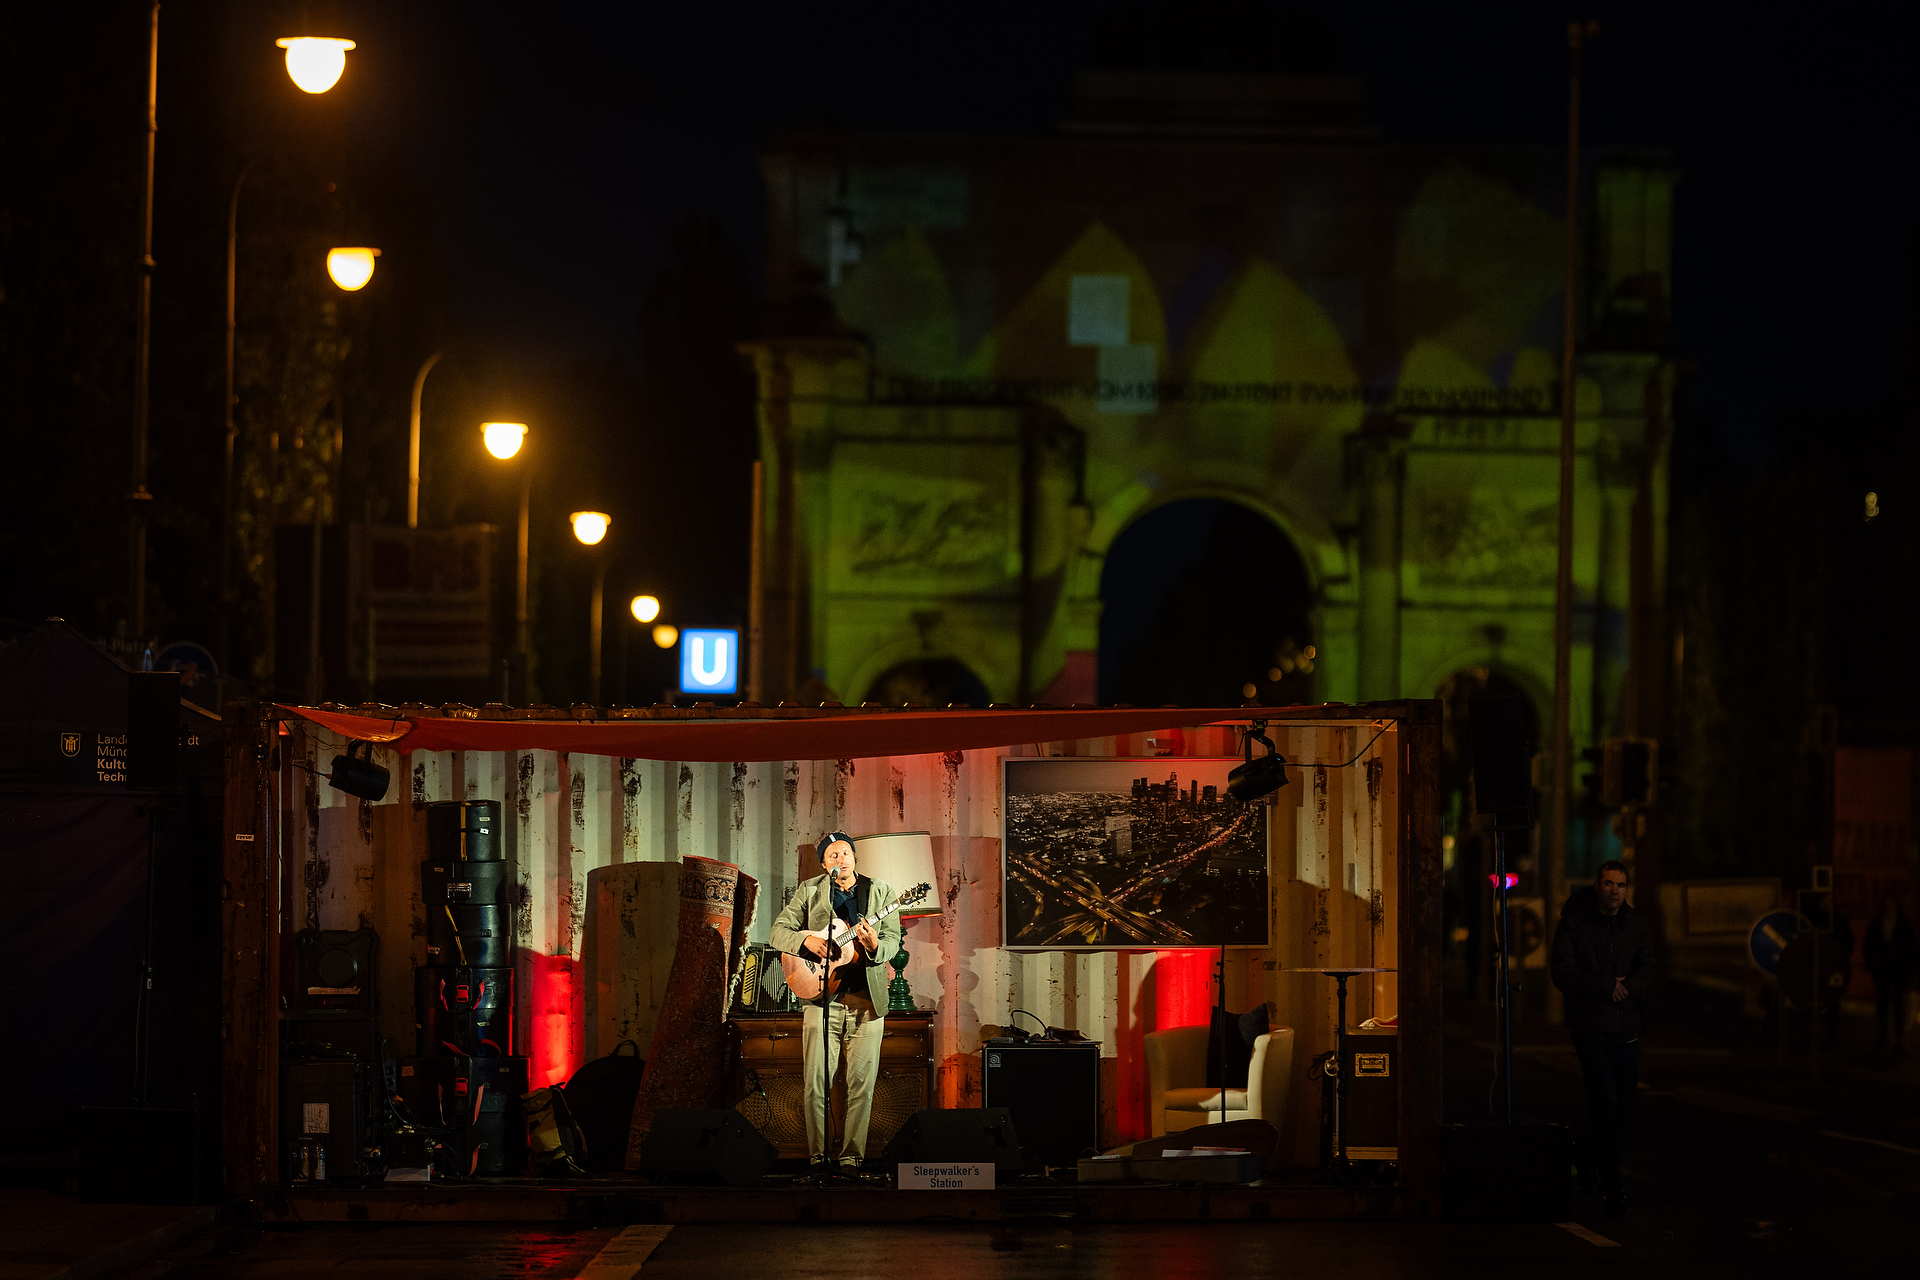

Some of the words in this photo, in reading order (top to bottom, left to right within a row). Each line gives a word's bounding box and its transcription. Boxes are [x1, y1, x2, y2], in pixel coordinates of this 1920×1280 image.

[691, 637, 728, 686] U
[913, 1165, 980, 1178] Sleepwalker's
[930, 1177, 963, 1188] Station
